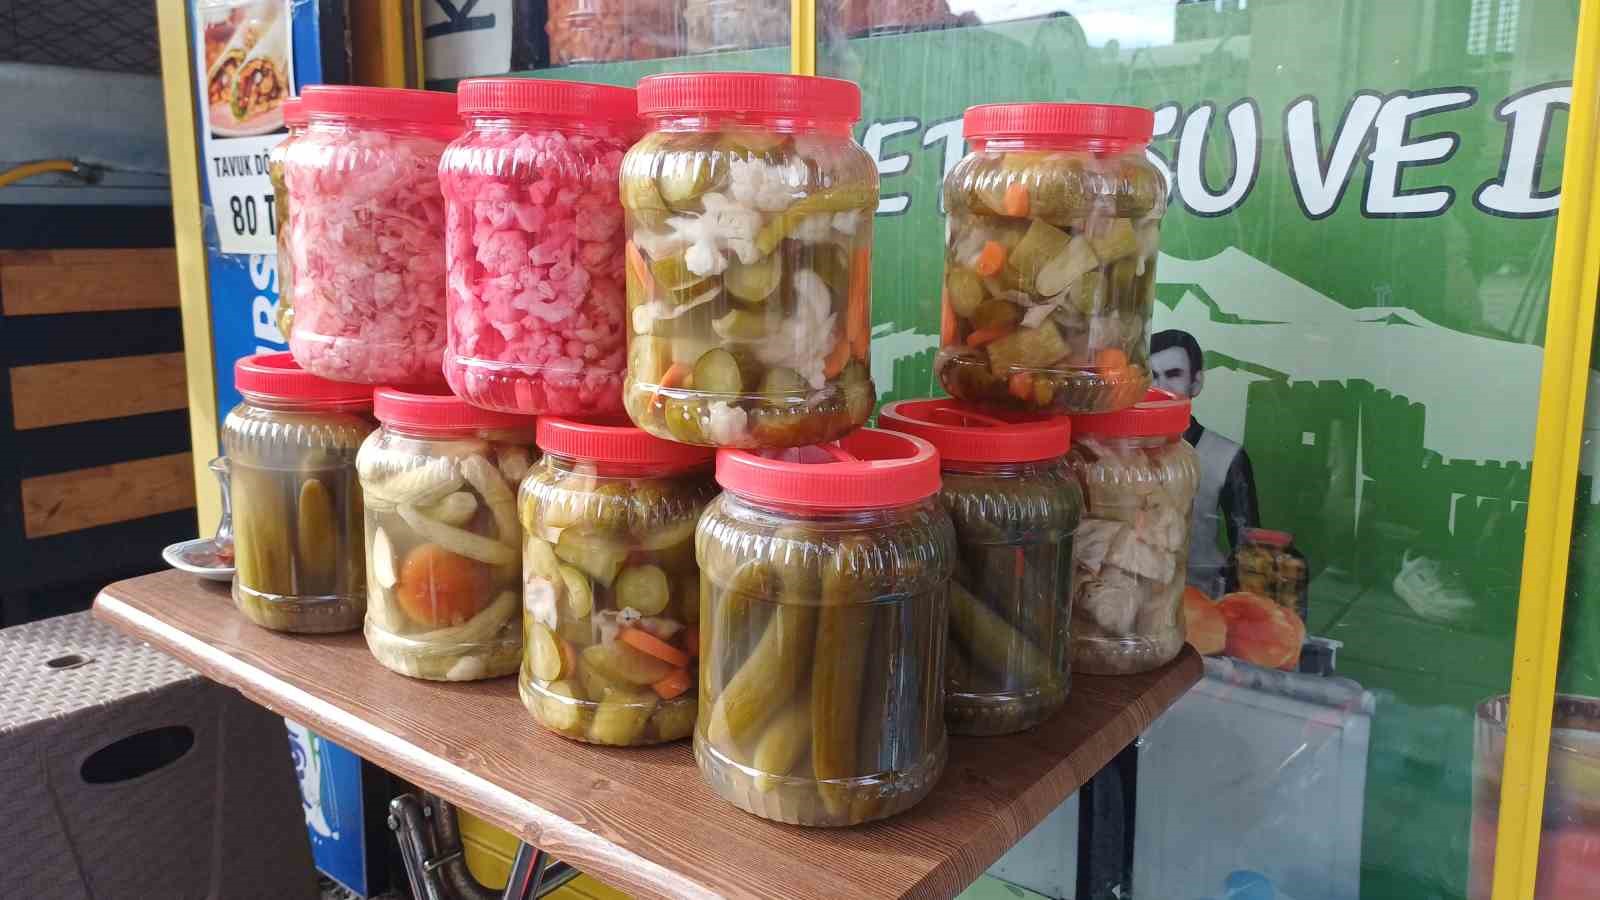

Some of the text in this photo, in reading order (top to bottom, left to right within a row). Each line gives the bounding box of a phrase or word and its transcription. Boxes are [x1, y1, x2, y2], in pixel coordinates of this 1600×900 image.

[213, 156, 252, 177] TAVUK
[1283, 86, 1479, 220] VE
[230, 195, 257, 236] 80
